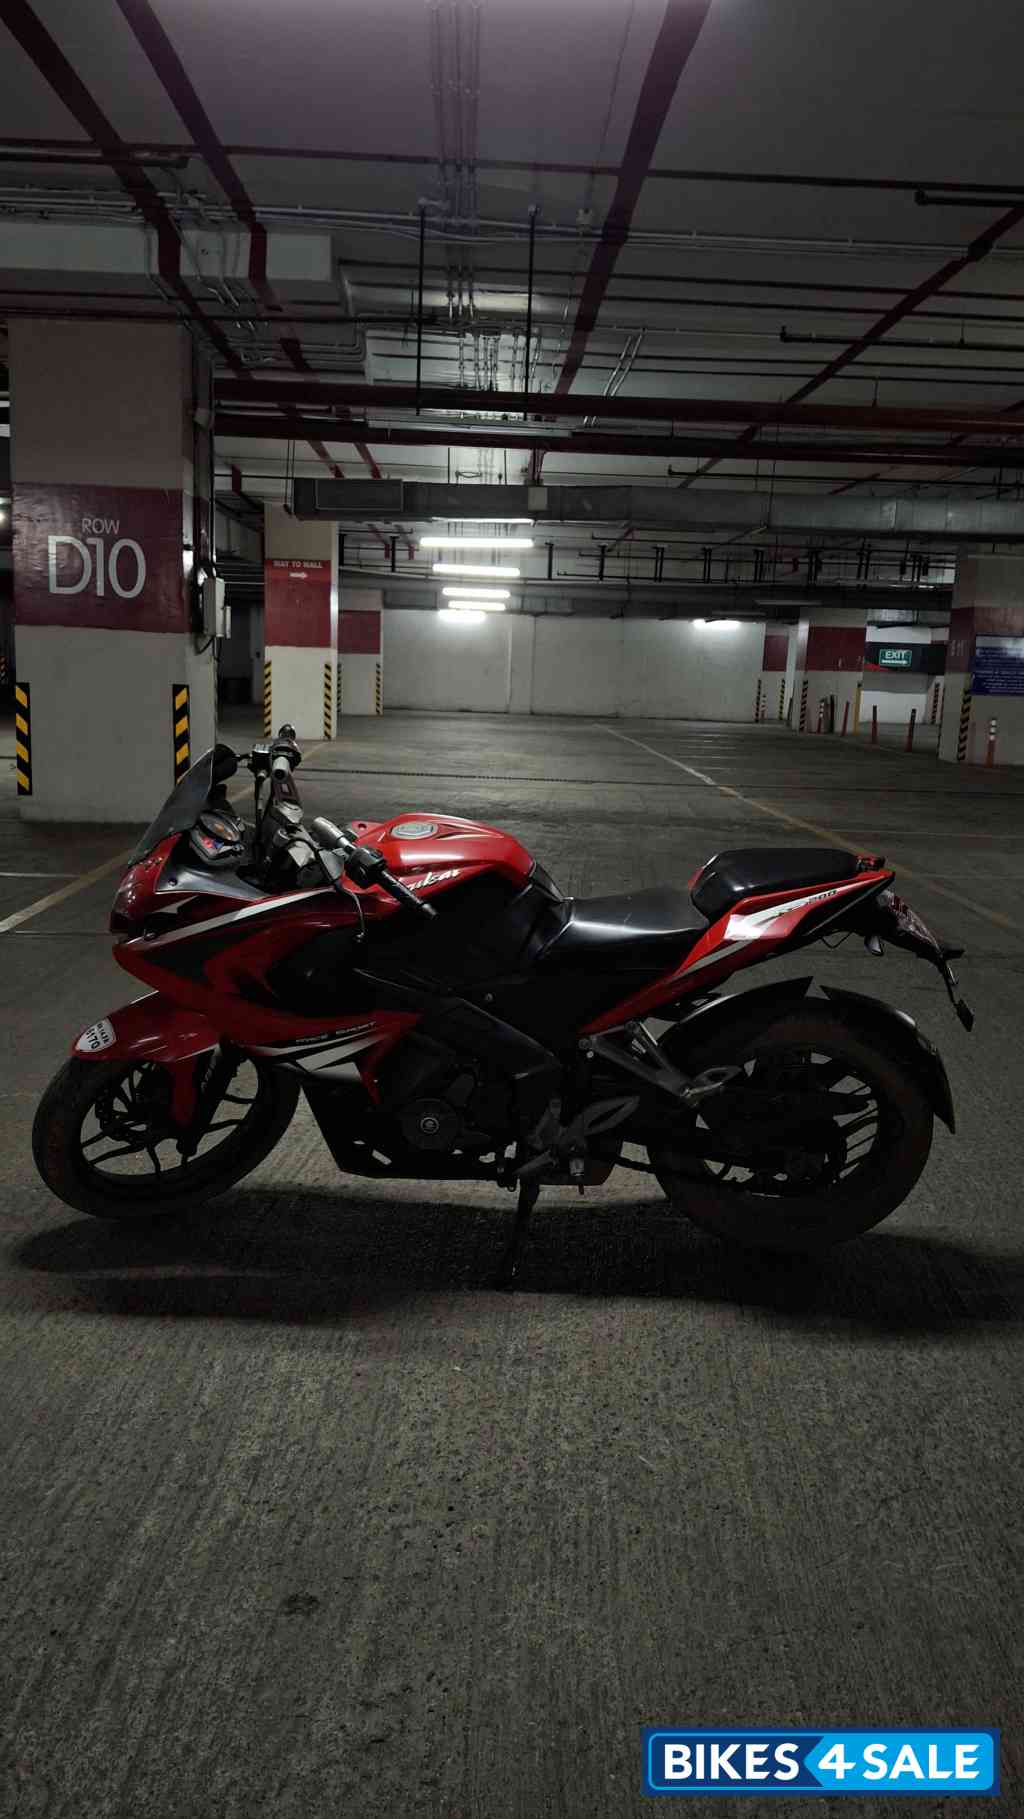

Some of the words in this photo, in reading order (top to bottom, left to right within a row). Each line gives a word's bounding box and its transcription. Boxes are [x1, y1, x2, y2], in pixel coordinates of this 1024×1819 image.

[81, 518, 120, 534] ROW
[48, 535, 146, 598] D10
[885, 650, 905, 659] EXIT
